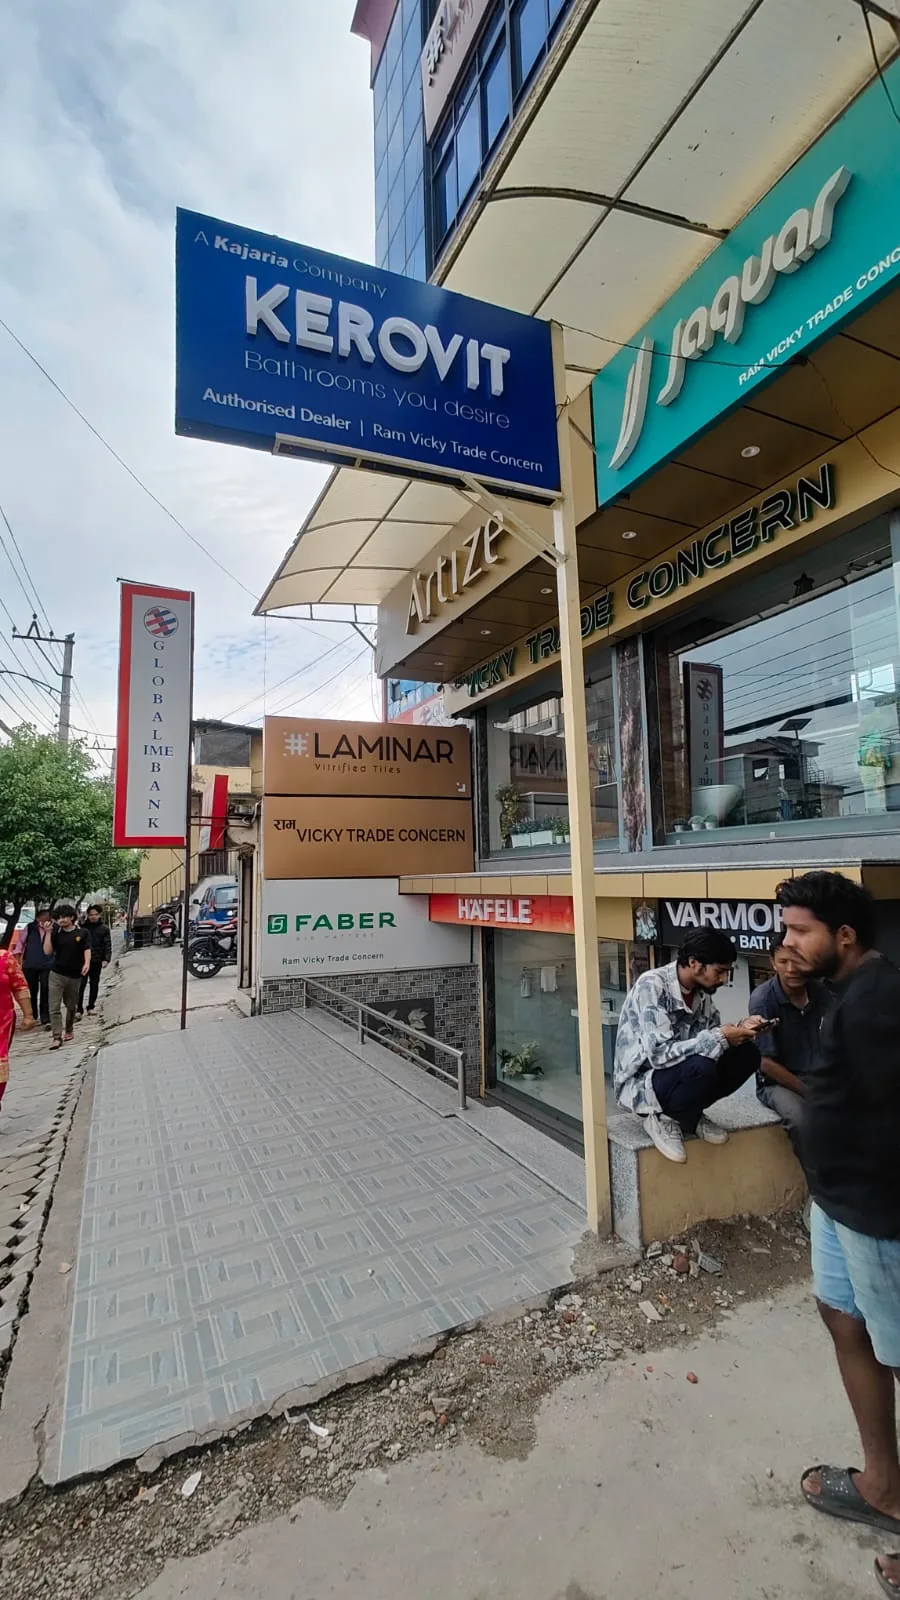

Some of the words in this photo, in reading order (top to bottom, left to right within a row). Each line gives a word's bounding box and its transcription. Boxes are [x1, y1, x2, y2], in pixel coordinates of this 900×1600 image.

[194, 230, 209, 246] A
[214, 235, 288, 269] Kajaria
[293, 258, 387, 299] Company
[244, 274, 511, 397] KEROVIT
[738, 357, 764, 386] RAM
[766, 324, 804, 362] VICKY
[806, 285, 854, 330] TRADE
[244, 350, 386, 400] Bathrooms
[393, 388, 437, 412] you
[444, 400, 510, 429] desire
[203, 387, 295, 419] Authorised
[301, 407, 352, 430] Dealer
[373, 423, 406, 442] Ram
[409, 431, 447, 453] Vicky
[451, 440, 487, 460] Trade
[490, 451, 543, 473] Concern
[525, 591, 613, 664] TRDE
[626, 463, 837, 611] CONCERN
[152, 640, 165, 741] GLOBAL
[143, 744, 175, 757] IME
[314, 732, 454, 764] LAMINAR
[315, 763, 367, 774] Vitrified
[373, 765, 400, 774] Tiles
[147, 761, 161, 829] BANK
[273, 819, 297, 831] राम
[296, 828, 344, 842] VICKY
[346, 828, 395, 842] TRADE
[398, 828, 466, 842] CONCERN
[295, 912, 397, 932] FABER
[282, 957, 300, 965] Ram
[303, 955, 325, 964] Vicky
[327, 954, 350, 962] Trade
[352, 952, 384, 961] Concern
